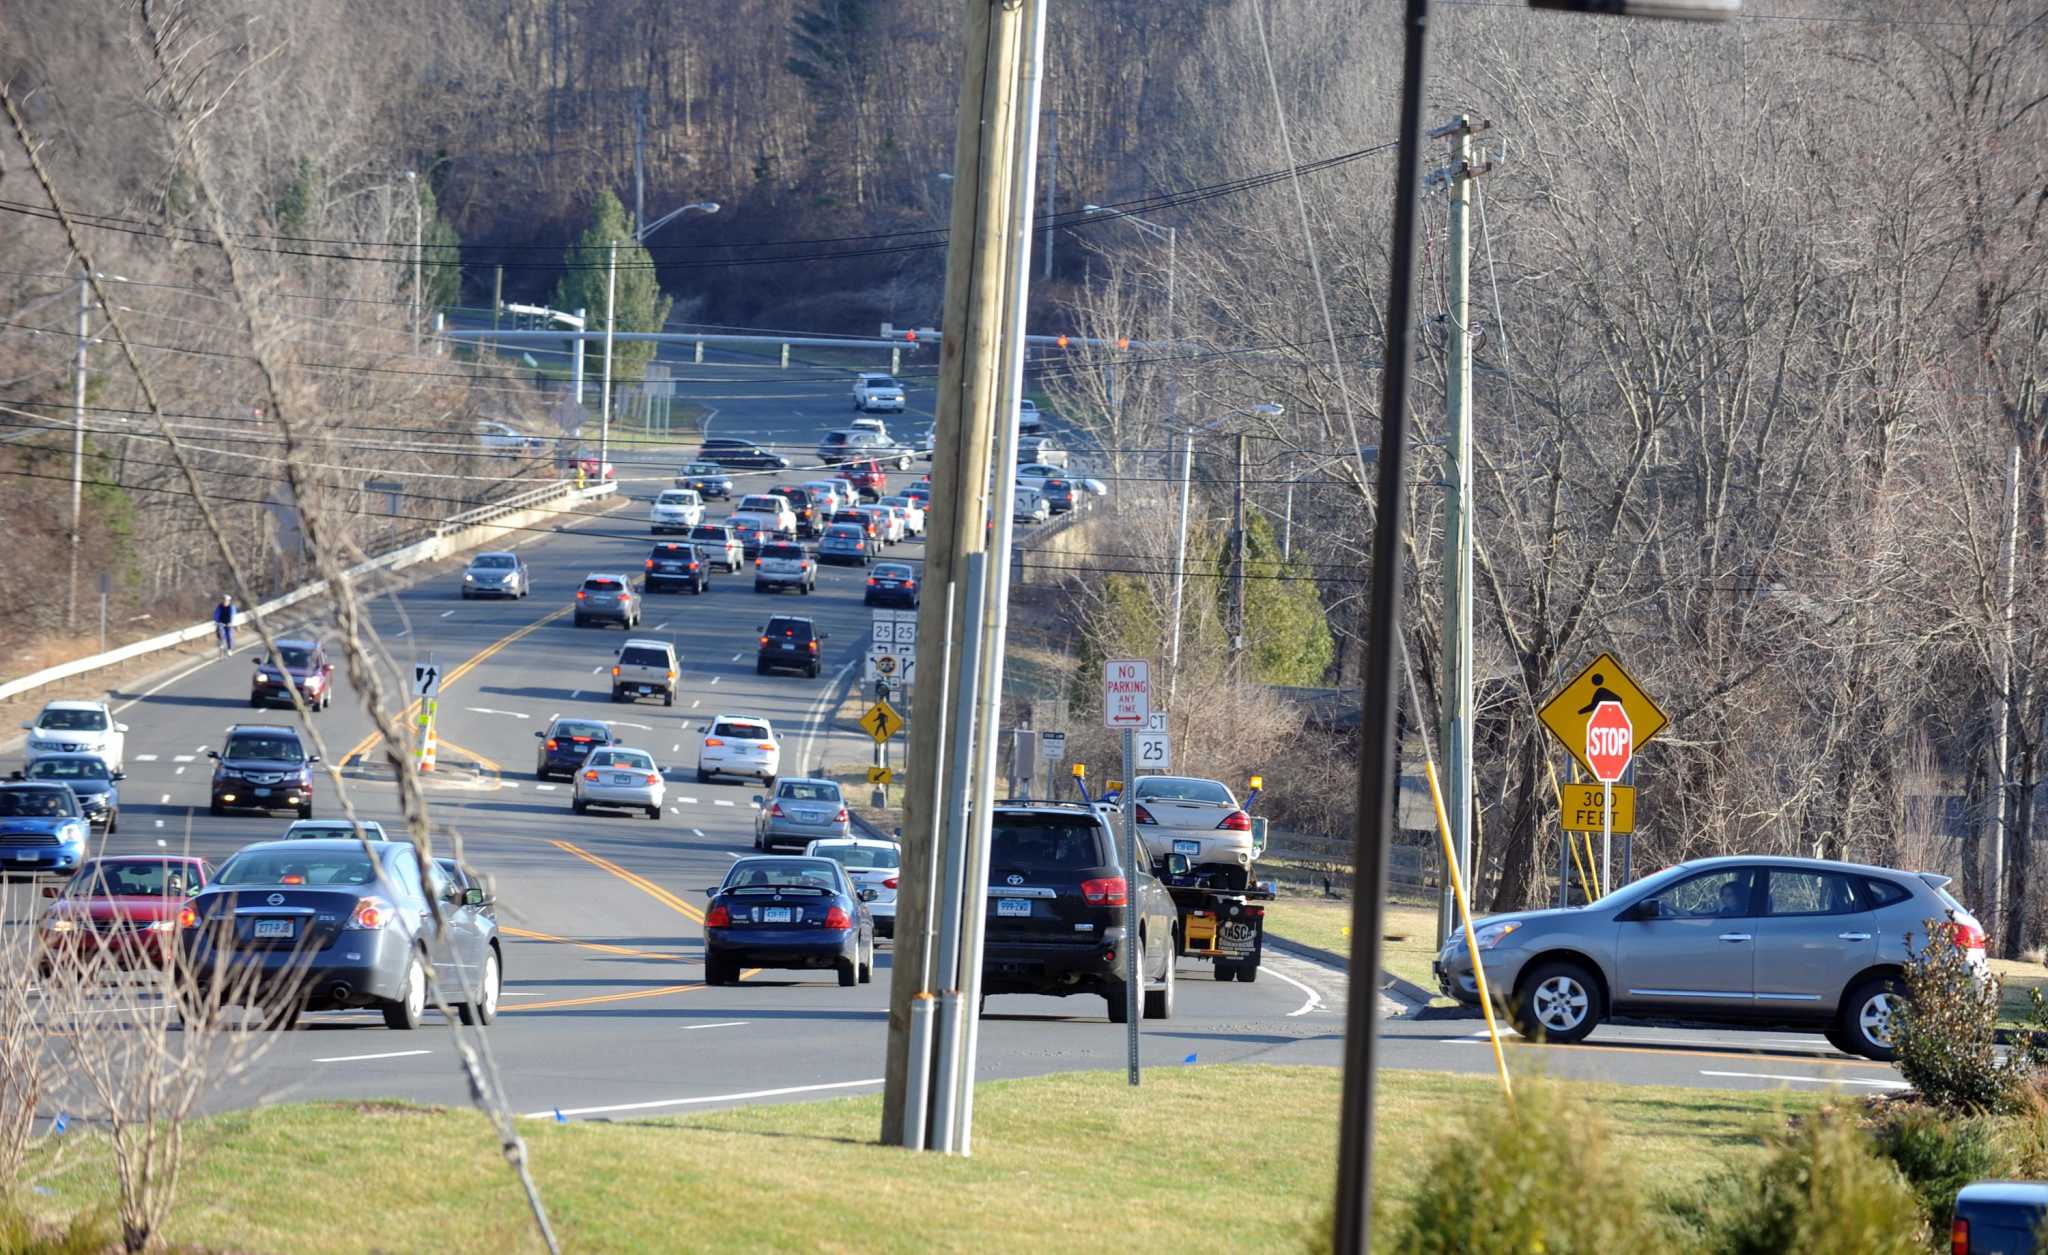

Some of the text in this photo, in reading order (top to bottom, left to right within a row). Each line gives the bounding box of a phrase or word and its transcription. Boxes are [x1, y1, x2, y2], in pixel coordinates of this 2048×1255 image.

[876, 625, 890, 638] 25
[899, 627, 913, 639] 25
[1118, 666, 1136, 679] NO
[1107, 681, 1146, 694] PARKING
[1119, 695, 1135, 704] ANY
[1118, 705, 1137, 713] TIME
[1148, 715, 1165, 729] CT
[1590, 727, 1629, 756] STOP
[1143, 741, 1163, 760] 25
